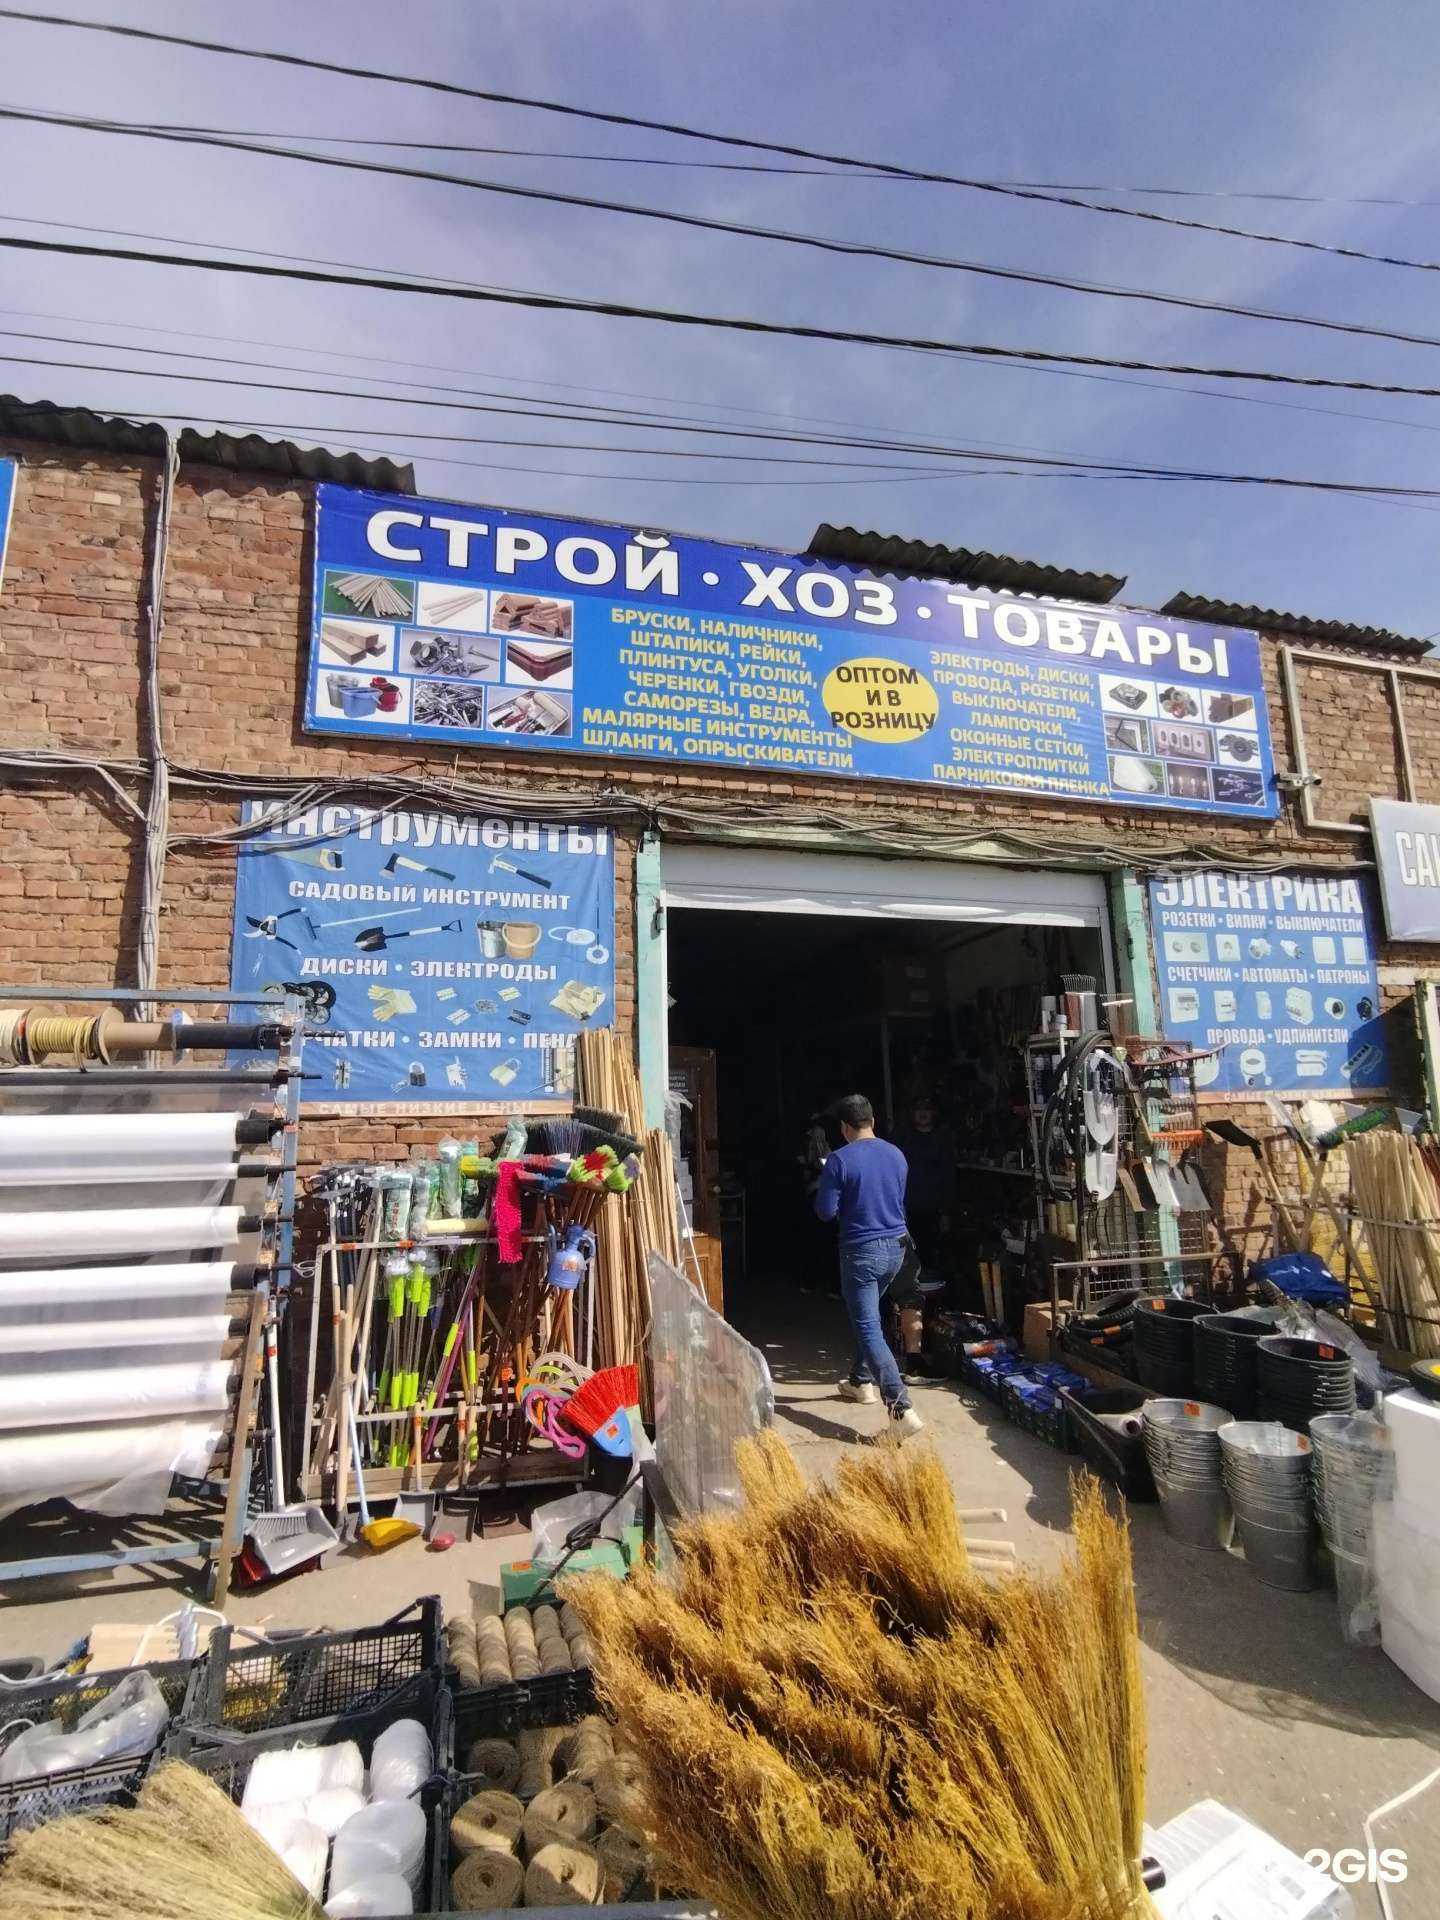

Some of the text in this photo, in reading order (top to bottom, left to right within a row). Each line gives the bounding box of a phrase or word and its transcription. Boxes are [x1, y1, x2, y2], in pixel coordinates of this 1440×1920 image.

[366, 510, 1229, 678] СТРОЙ ХОЗ ТОВАРЫ
[611, 607, 824, 652] БРУСКИ, НАЛИЧНИКИ,
[631, 630, 806, 668] ШТАПИКИ, РЕЙКИ,
[619, 648, 818, 689] ПЛИНТУСА, УГОЛКИ,
[836, 666, 919, 686] ОПТОМ
[930, 651, 1095, 688] ЭЛЕКТРОДЫ, ДИСКИ,
[629, 669, 810, 707] ЧЕРЕНКИ, ГВОЗДИ,
[866, 689, 901, 706] И В
[933, 670, 1095, 707] ПРОВОДА, РОЗЕТКИ,
[624, 690, 815, 727] САМОРЕЗЫ, ВЕДРА,
[831, 710, 936, 733] РОЗНИЦУ
[952, 691, 1082, 722] ВЫКЛЮЧАТЕЛИ,
[583, 707, 852, 748] МАЛЯРНЫЕ ИНСТРУМЕНТЫ
[970, 710, 1067, 739] ЛАМПОЧКИ,
[583, 728, 853, 768] ШЛАНГИ, ОПРЫСКИВАТЕЛИ
[950, 728, 1089, 758] ОКОННЫЕ СЕТКИ,
[952, 747, 1089, 775] ЭЛЕКТРОПЛИТКИ
[933, 764, 1109, 797] ПАРНИКОВАЯ ПЛЕНКА
[289, 879, 571, 910] САДОВЫЙ ИНСТРУМЕНТ
[1156, 874, 1364, 914] ЭЛЕКТРИКА
[1162, 912, 1363, 932] РОЗЕТКИ ВИЛКИ ВЫКЛЮЧАТЕЛИ
[300, 958, 557, 981] ДИСКИ ЭЛЕКТРОДЫ
[1167, 966, 1370, 984] СЧЕТЧИКИ АВТОМАТЫ ПАТРОНЫ
[419, 1032, 502, 1048] ЗАМКИ
[1207, 1028, 1349, 1044] ПРОВОДА УДЛИНИТЕЛИ
